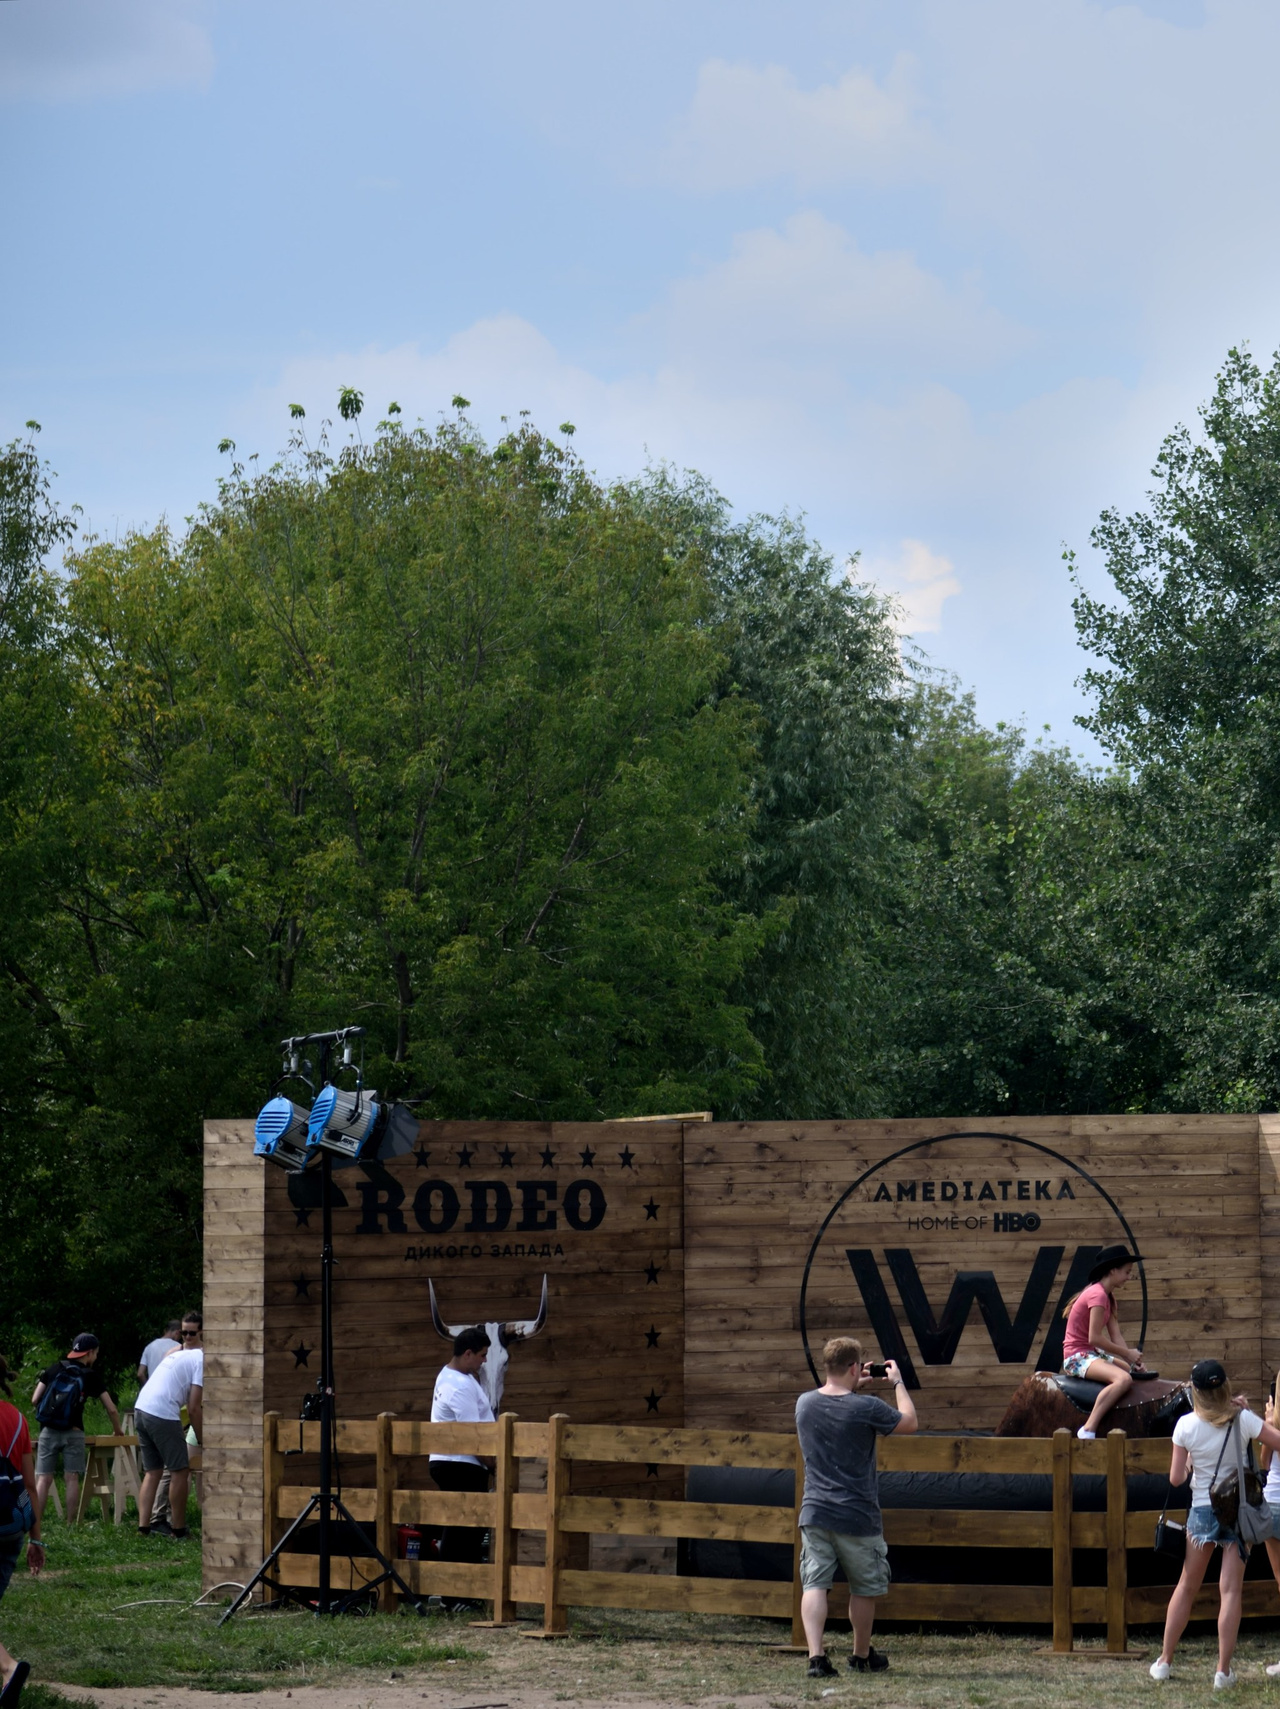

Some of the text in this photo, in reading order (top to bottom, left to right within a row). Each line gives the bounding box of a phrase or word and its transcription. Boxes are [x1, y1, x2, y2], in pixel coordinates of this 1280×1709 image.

[873, 1180, 1076, 1202] AMEDIATEKA
[356, 1180, 607, 1233] RODEO
[908, 1212, 1041, 1233] HOME OF HBO
[404, 1243, 564, 1261] ДИКОГО ЗАПАДА
